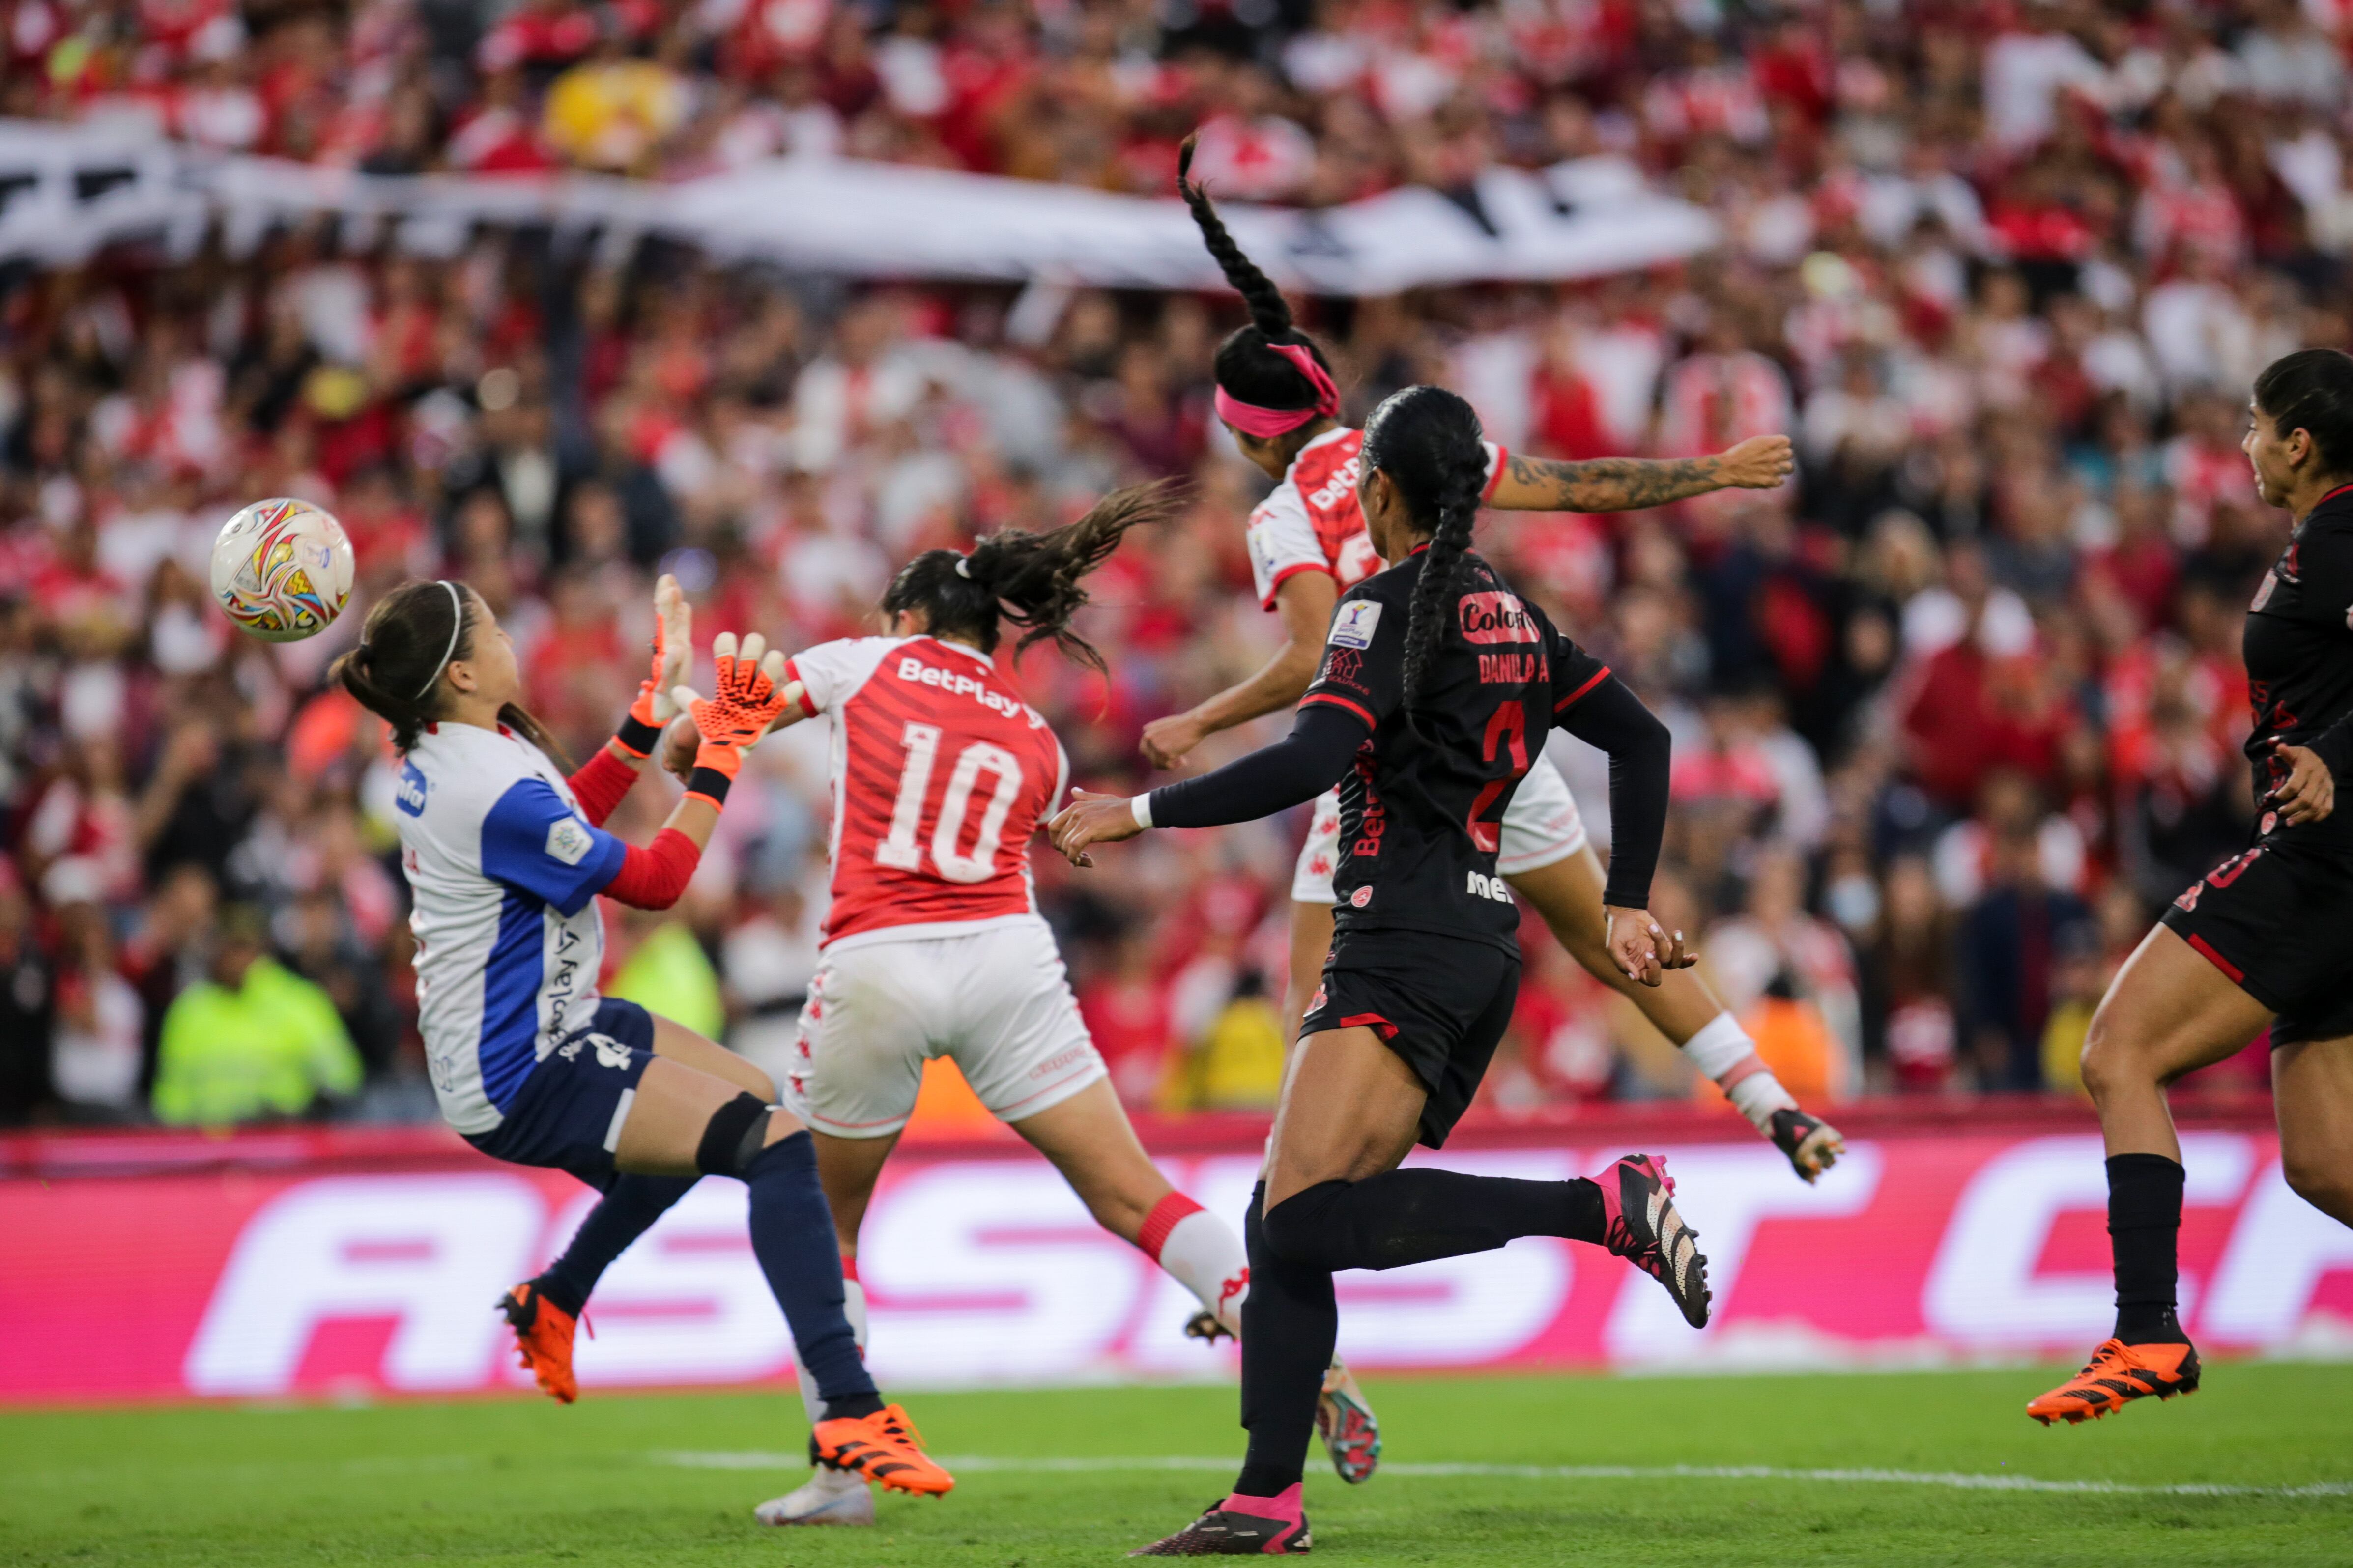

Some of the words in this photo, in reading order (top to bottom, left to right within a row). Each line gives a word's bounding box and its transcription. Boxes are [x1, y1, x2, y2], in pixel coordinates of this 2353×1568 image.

[1308, 456, 1360, 511] BetP
[873, 720, 1024, 884] 10
[1467, 700, 1529, 853] 2
